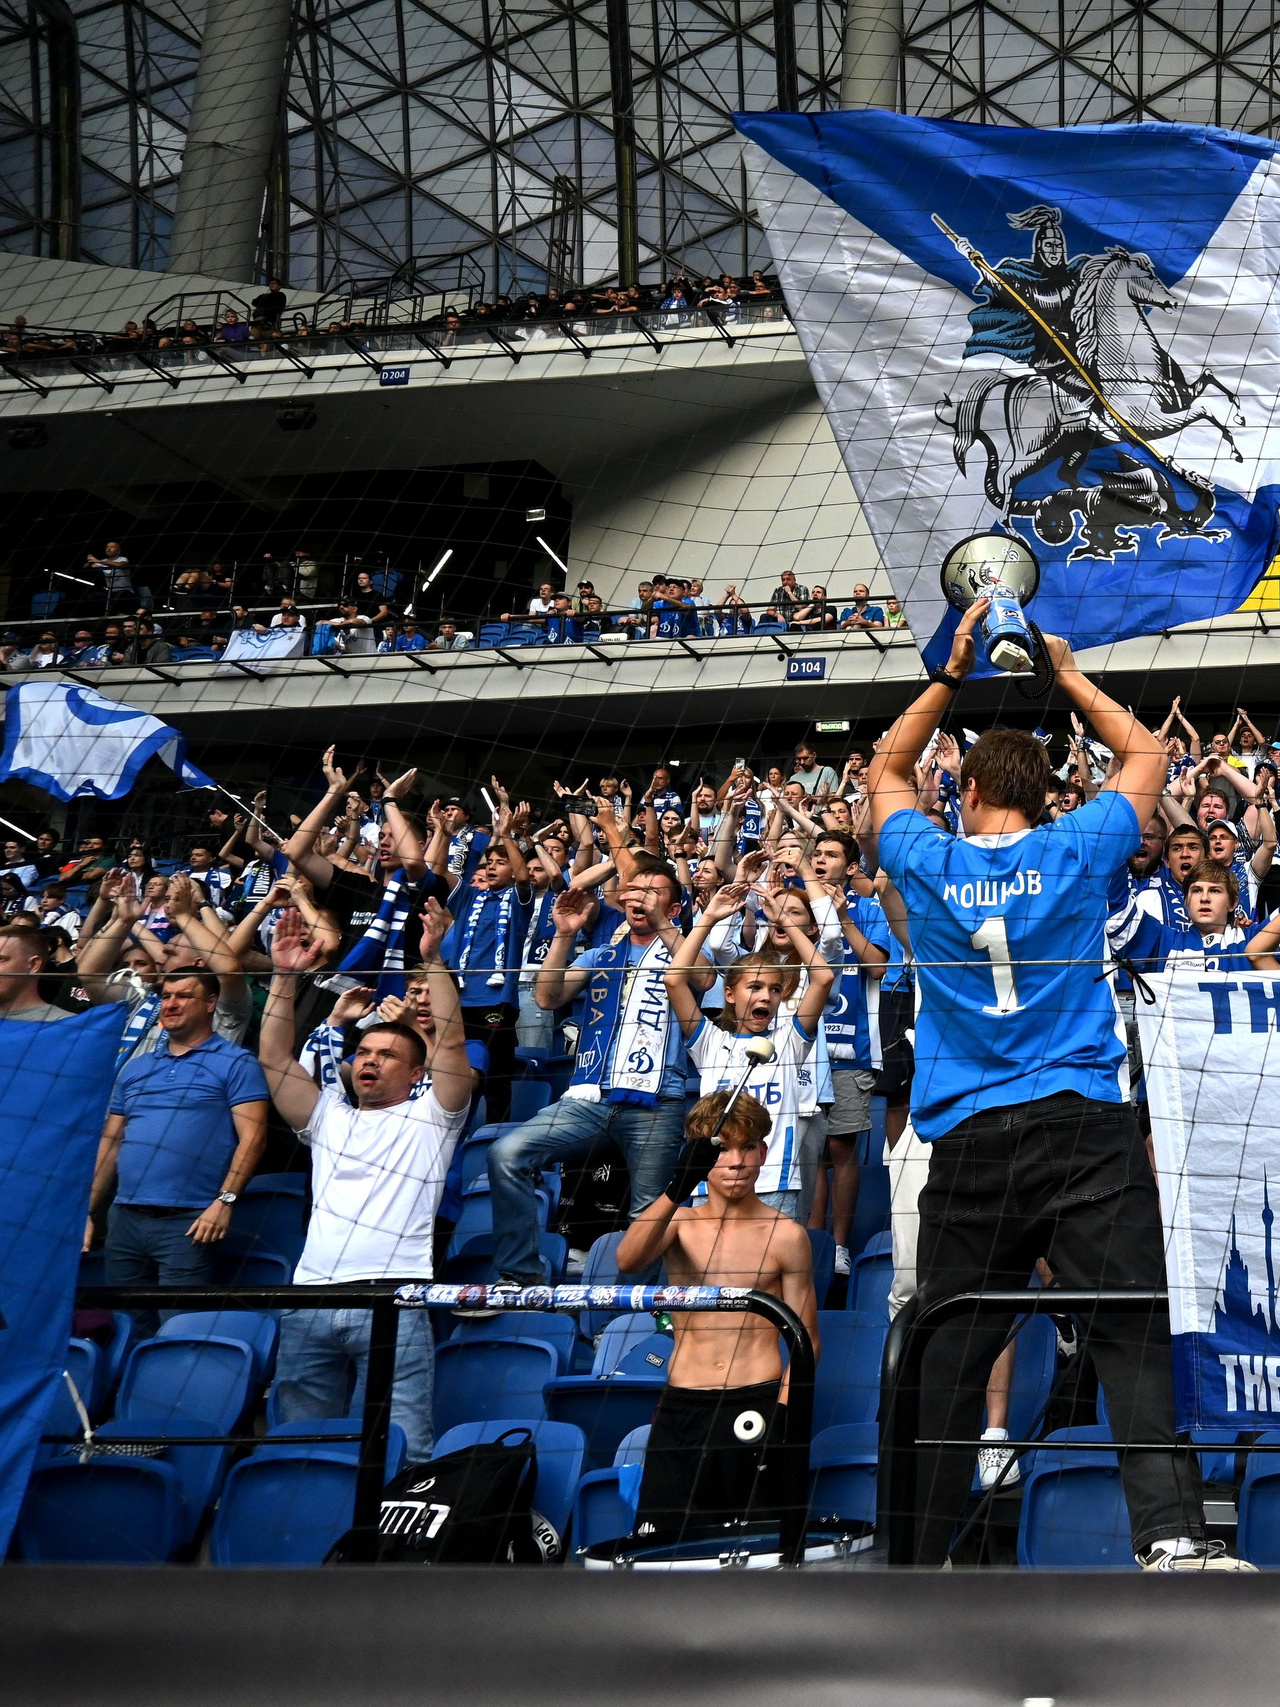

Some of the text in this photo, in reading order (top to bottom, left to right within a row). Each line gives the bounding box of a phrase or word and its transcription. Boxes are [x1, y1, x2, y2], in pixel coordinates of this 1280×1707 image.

[382, 371, 406, 380] D 204
[790, 661, 821, 673] D 104
[588, 949, 617, 1026] СКВА
[970, 915, 1027, 1016] 1
[636, 945, 672, 1032] ДИНА
[625, 1076, 651, 1088] 1923
